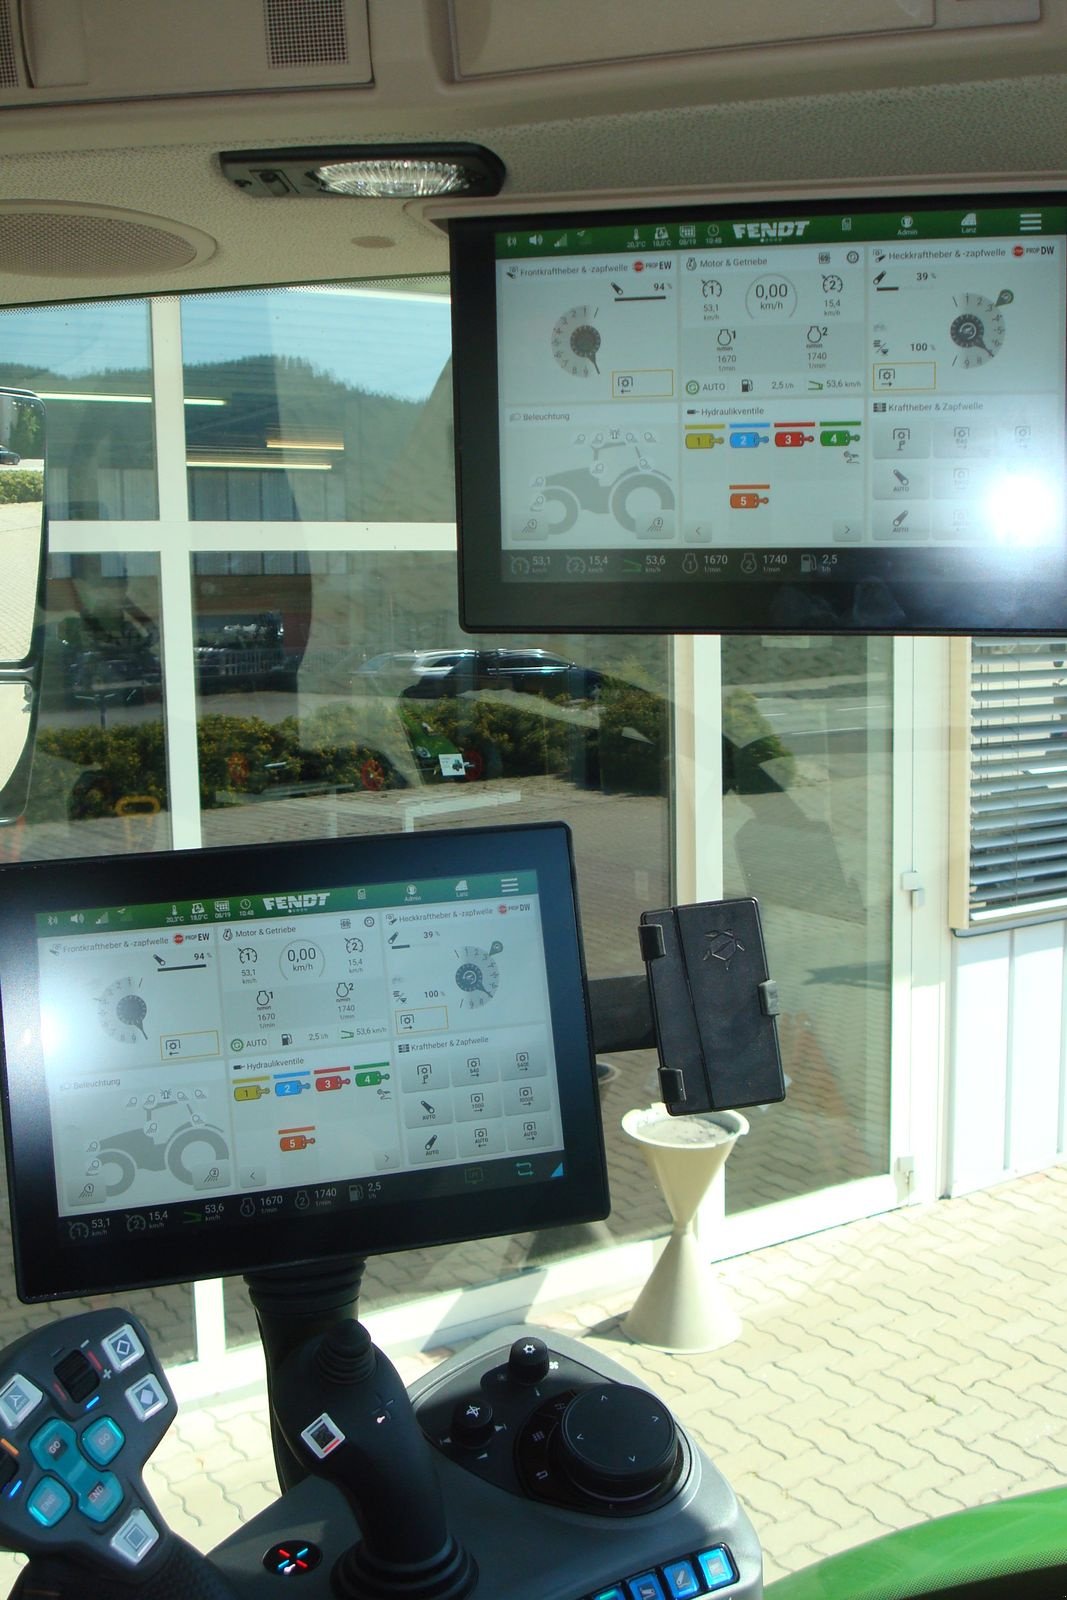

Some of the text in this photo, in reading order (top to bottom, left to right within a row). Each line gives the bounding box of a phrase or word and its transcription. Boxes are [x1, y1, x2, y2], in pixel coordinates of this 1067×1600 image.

[733, 220, 810, 239] FENDT
[888, 251, 952, 260] Heckkraftheber
[954, 250, 961, 258] &
[1041, 246, 1054, 255] DW
[659, 261, 672, 270] EW
[700, 257, 768, 268] Motor & Getriebe
[520, 267, 579, 277] Frontkraftheber
[581, 265, 587, 274] &
[916, 272, 928, 281] 39
[653, 282, 665, 291] 94
[709, 285, 714, 294] 1
[829, 281, 836, 290] 2
[755, 284, 788, 300] 0,00
[760, 301, 784, 311] km/h
[824, 299, 841, 308] 15,4
[703, 304, 719, 313] 53,1
[731, 331, 736, 339] 1
[822, 327, 828, 336] 2
[910, 343, 928, 351] 100
[717, 355, 737, 363] 1670
[807, 352, 827, 361] 1740
[702, 383, 726, 391] AUTO
[771, 381, 784, 390] 2,5
[826, 380, 844, 389] 53,6
[888, 402, 984, 412] Kraftheber & Zapfwelle
[701, 407, 764, 417] Hydraulikventile
[523, 413, 570, 422] Beleuchtung
[696, 437, 701, 446] 1
[740, 436, 747, 445] 2
[785, 435, 792, 444] 3
[830, 434, 838, 443] 4
[740, 496, 747, 506] 5
[532, 556, 550, 565] 53,1
[589, 556, 608, 565] 15,4
[646, 555, 666, 565] 53,6
[704, 555, 728, 564] 1670
[763, 554, 788, 564] 1740
[822, 555, 838, 565] 2,5
[262, 893, 330, 911] FENDT
[399, 912, 451, 922] Heckkraftheber
[235, 926, 296, 938] Motor & Getriebe
[423, 931, 434, 939] 39
[198, 933, 210, 942] EW
[63, 943, 122, 953] Frontkraftheber
[131, 937, 169, 948] -zapfwelle
[352, 942, 358, 951] 2
[194, 952, 205, 961] 94
[287, 947, 316, 963] 0,00
[348, 958, 363, 967] 15,4
[292, 963, 314, 972] km/h
[241, 969, 256, 977] 53,1
[349, 983, 354, 991] 2
[270, 991, 274, 999] 1
[424, 990, 439, 998] 100
[337, 1005, 355, 1013] 1740
[257, 1013, 276, 1022] 1670
[356, 1027, 371, 1036] 53,6
[308, 1033, 320, 1041] 2,5
[246, 1039, 267, 1047] AUTO
[411, 1041, 448, 1051] Kraftheber
[456, 1036, 489, 1047] Zapfwelle
[246, 1057, 304, 1070] Hydraulikventile
[73, 1077, 121, 1090] Beleuchtung
[324, 1080, 331, 1088] 3
[364, 1075, 370, 1084] 4
[284, 1084, 291, 1093] 2
[289, 1139, 296, 1148] 5
[367, 1182, 382, 1191] 2,5
[314, 1188, 337, 1198] 1740
[260, 1195, 283, 1206] 1670
[204, 1203, 225, 1214] 53,6
[149, 1211, 168, 1221] 15,4
[91, 1219, 110, 1229] 53,1
[99, 1432, 111, 1446] GO
[48, 1440, 61, 1454] GO
[88, 1485, 104, 1503] END
